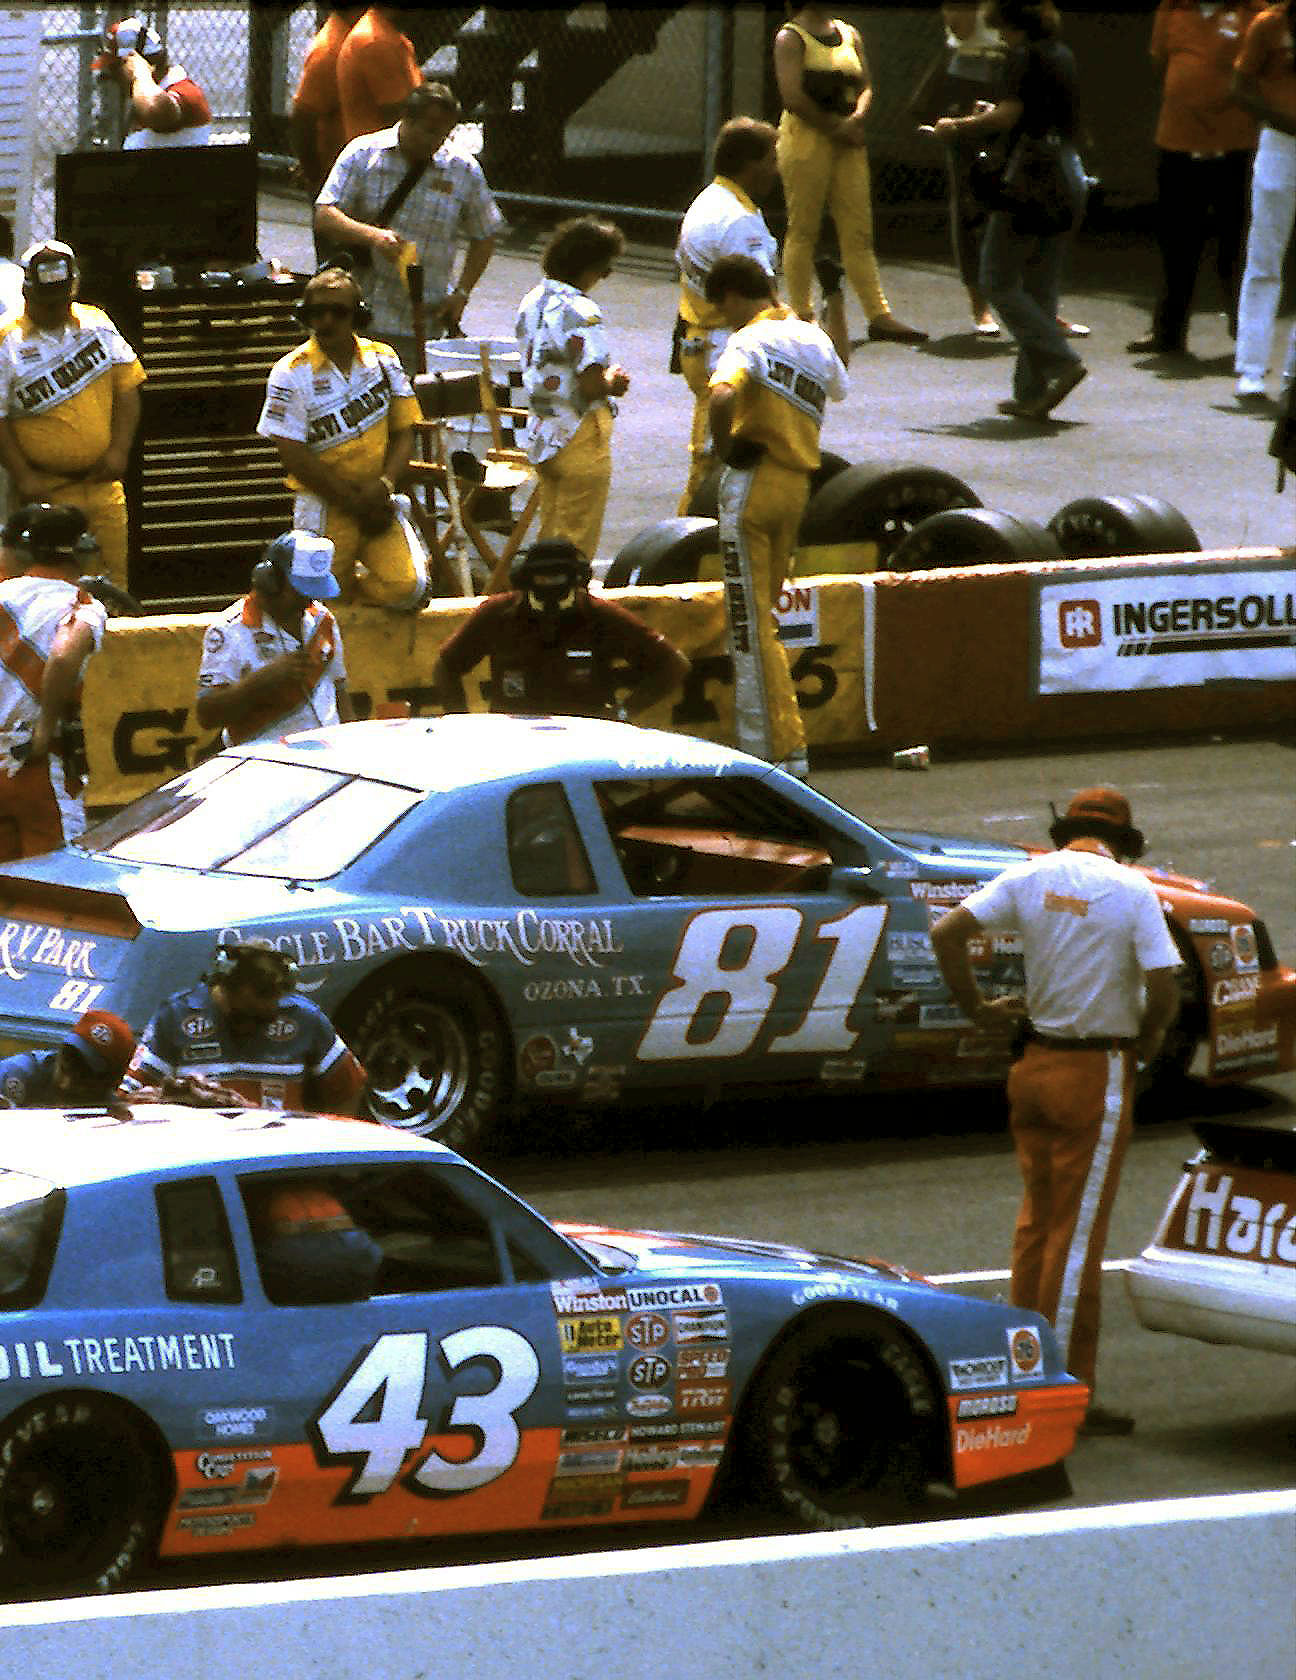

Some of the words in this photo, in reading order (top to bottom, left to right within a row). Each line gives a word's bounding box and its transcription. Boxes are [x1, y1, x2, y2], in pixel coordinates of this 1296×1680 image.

[1112, 593, 1296, 636] INGERSOLL
[31, 928, 97, 978] PARK
[333, 917, 416, 962] BAR
[400, 906, 536, 967] TRUCK
[515, 909, 625, 967] CORRAL
[49, 979, 104, 1013] 81
[636, 904, 891, 1061] 81
[554, 1293, 628, 1313] Winston
[630, 1287, 704, 1308] UNOCAL
[630, 1315, 665, 1345] STP
[66, 1332, 237, 1376] TREATMENT
[633, 1357, 667, 1385] STP
[316, 1324, 542, 1497] 43
[955, 1421, 1032, 1454] DieHard
